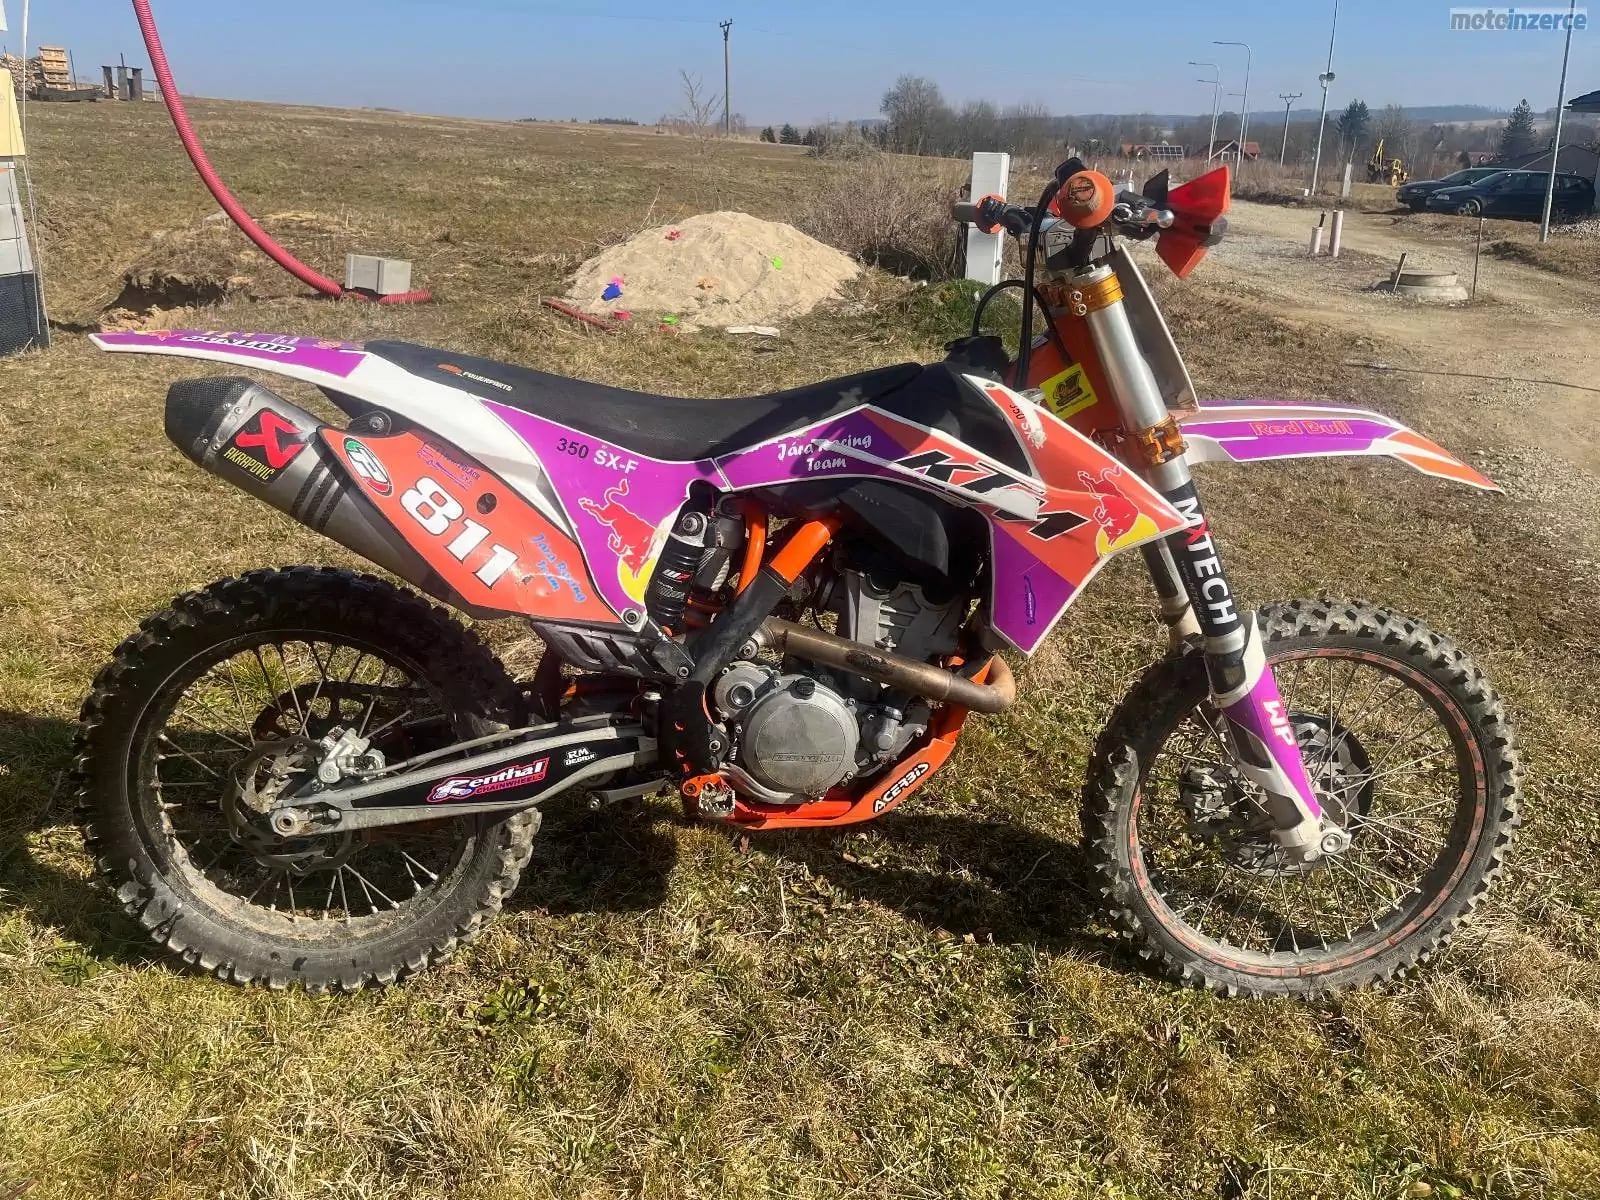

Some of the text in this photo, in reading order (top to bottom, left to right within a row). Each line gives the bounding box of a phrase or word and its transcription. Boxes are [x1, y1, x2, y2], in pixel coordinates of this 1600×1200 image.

[1248, 421, 1354, 436] Red Bull
[556, 438, 639, 474] 350 SX-F
[778, 442, 813, 461] Jára
[806, 457, 846, 471] Team
[400, 477, 519, 590] 811
[1172, 496, 1238, 626] MXTECH
[1262, 700, 1296, 747] WP
[568, 748, 590, 759] RM
